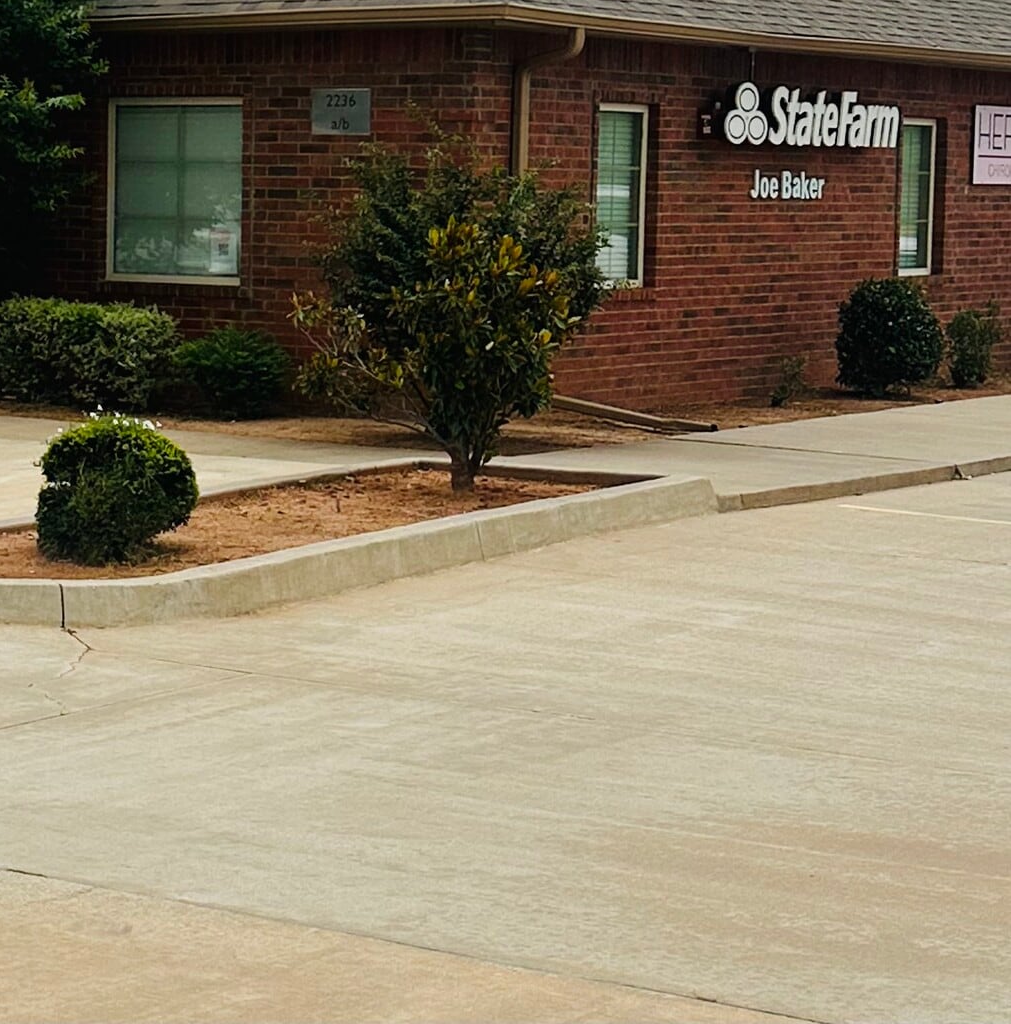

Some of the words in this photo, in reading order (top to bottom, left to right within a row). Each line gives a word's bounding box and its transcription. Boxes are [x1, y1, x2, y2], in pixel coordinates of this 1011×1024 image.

[326, 93, 357, 108] 2236
[330, 117, 350, 130] a/b
[750, 169, 779, 199] Joe
[781, 171, 826, 200] Baker
